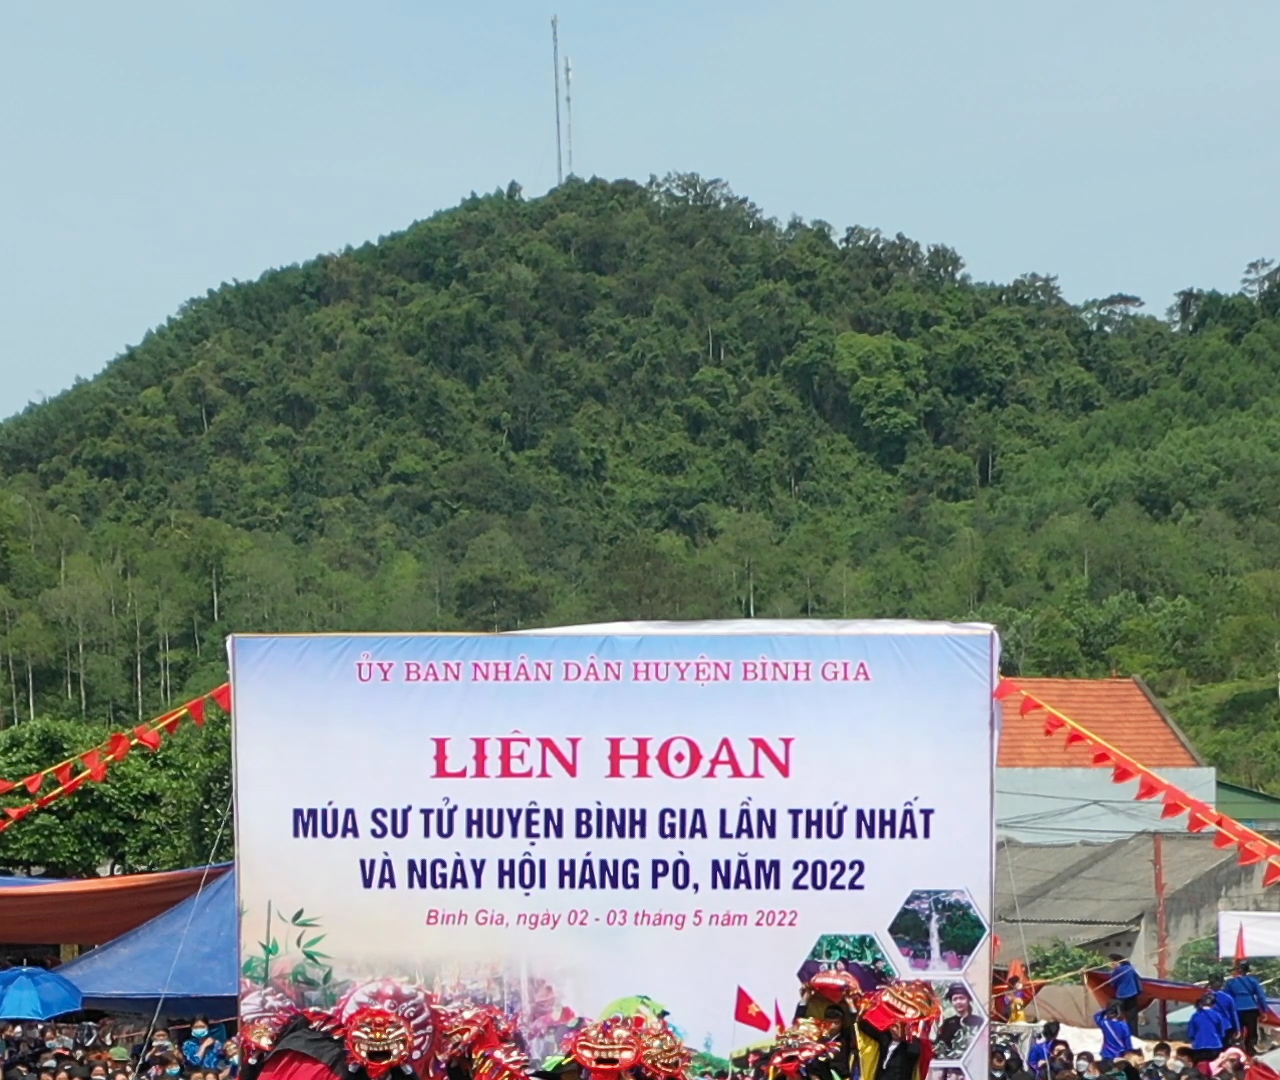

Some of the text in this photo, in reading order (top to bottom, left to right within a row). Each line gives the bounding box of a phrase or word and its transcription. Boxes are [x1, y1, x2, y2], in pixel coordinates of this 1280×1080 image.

[356, 653, 871, 687] ỦY BAN NHÂN DÂN HUYỆN BÌNH GIA
[430, 730, 795, 779] LIÊN HOAN
[292, 796, 935, 846] MÚA SƯ TỬ HUYỆN BÌNH GIA LẦN THỨ NHẤT
[359, 850, 866, 897] VÀ NGÀY HỘI HÁNG PÒ, NĂM 2022
[475, 908, 509, 928] Gia,
[516, 908, 561, 930] ngày
[567, 909, 589, 926] 02
[606, 909, 628, 926] 03
[634, 908, 685, 930] tháng
[692, 909, 703, 926] 5
[709, 908, 748, 926] năm
[755, 909, 798, 927] 2022
